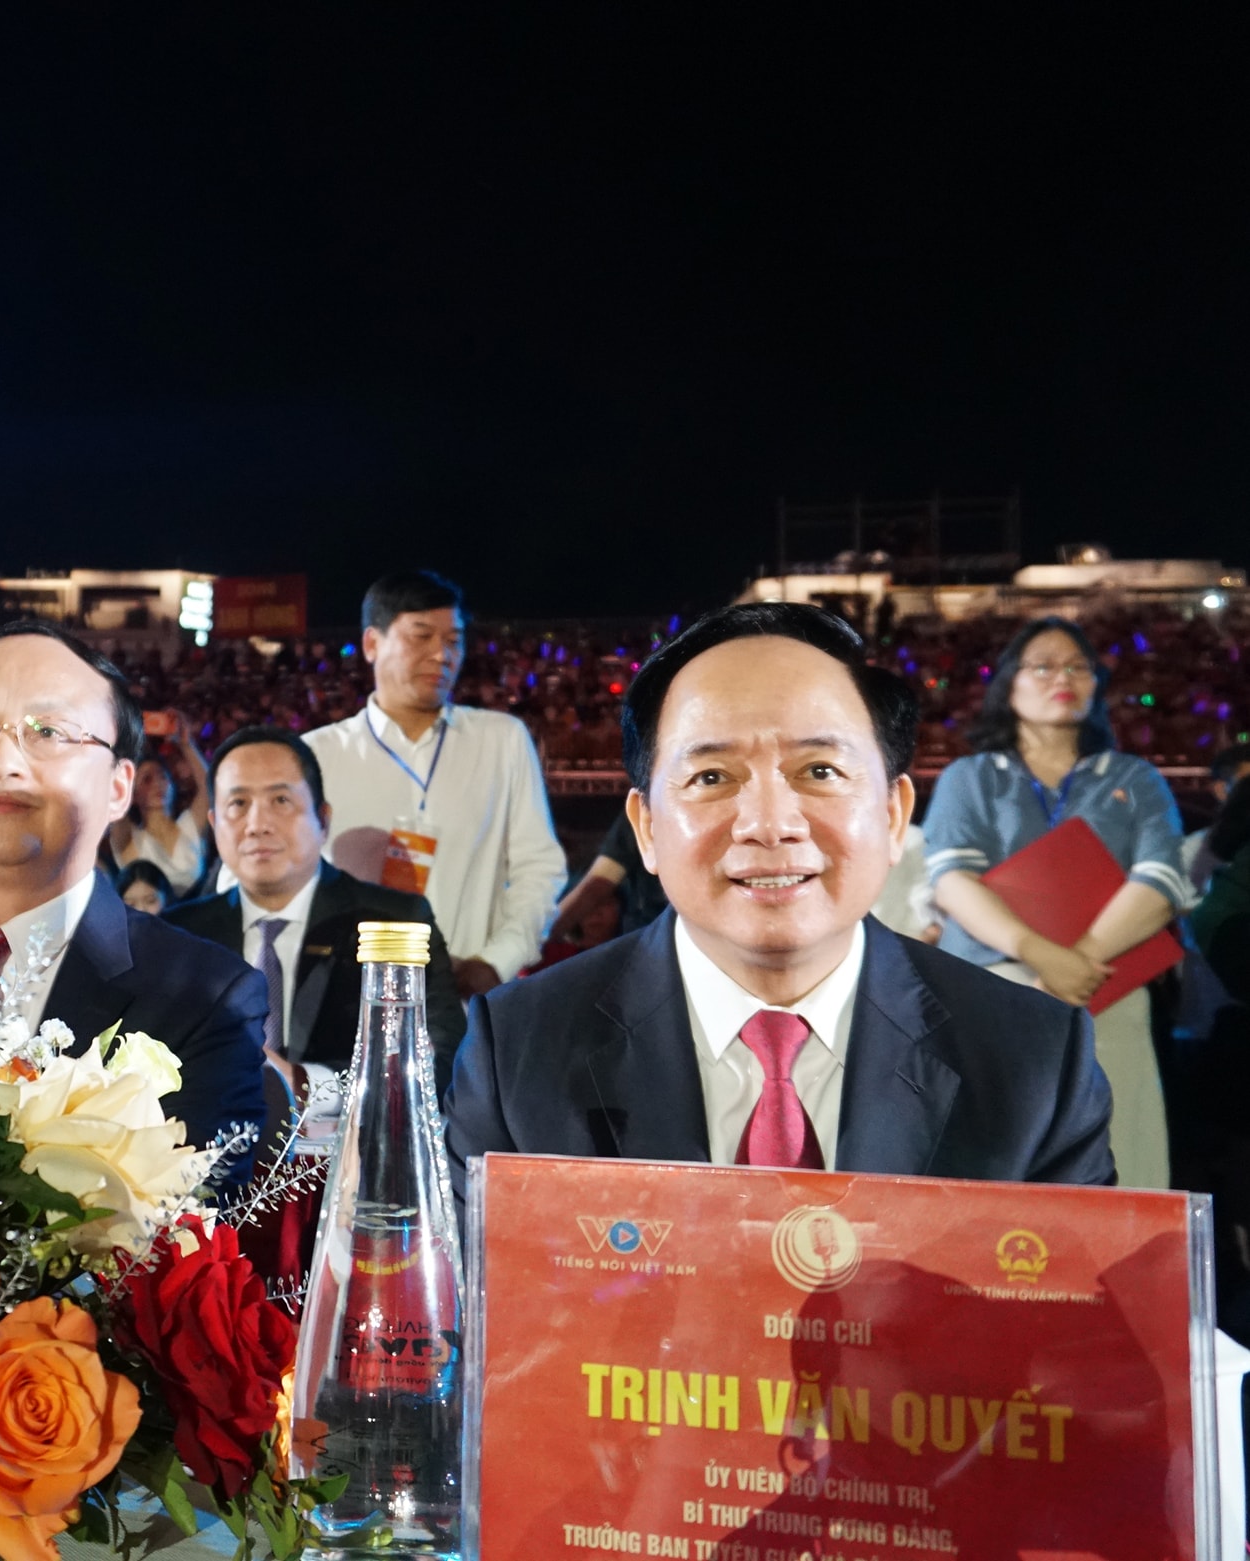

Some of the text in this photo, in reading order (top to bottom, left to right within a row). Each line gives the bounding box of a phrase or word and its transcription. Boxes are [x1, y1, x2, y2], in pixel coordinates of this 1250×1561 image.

[554, 1255, 697, 1276] TIẾNG NÓI VIỆT NAM
[764, 1307, 872, 1346] ĐỒNG CHÍ
[581, 1362, 1074, 1463] TRỊNH VĂN QUYẾT
[704, 1460, 936, 1515] ỦY VIÊN BỘ CHÍNH TRỊ,
[563, 1521, 641, 1555] TRƯỞNG
[647, 1533, 689, 1561] BAN
[683, 1500, 959, 1555] BÍ THƯ TRUNG ƯƠNG ĐẢNG,
